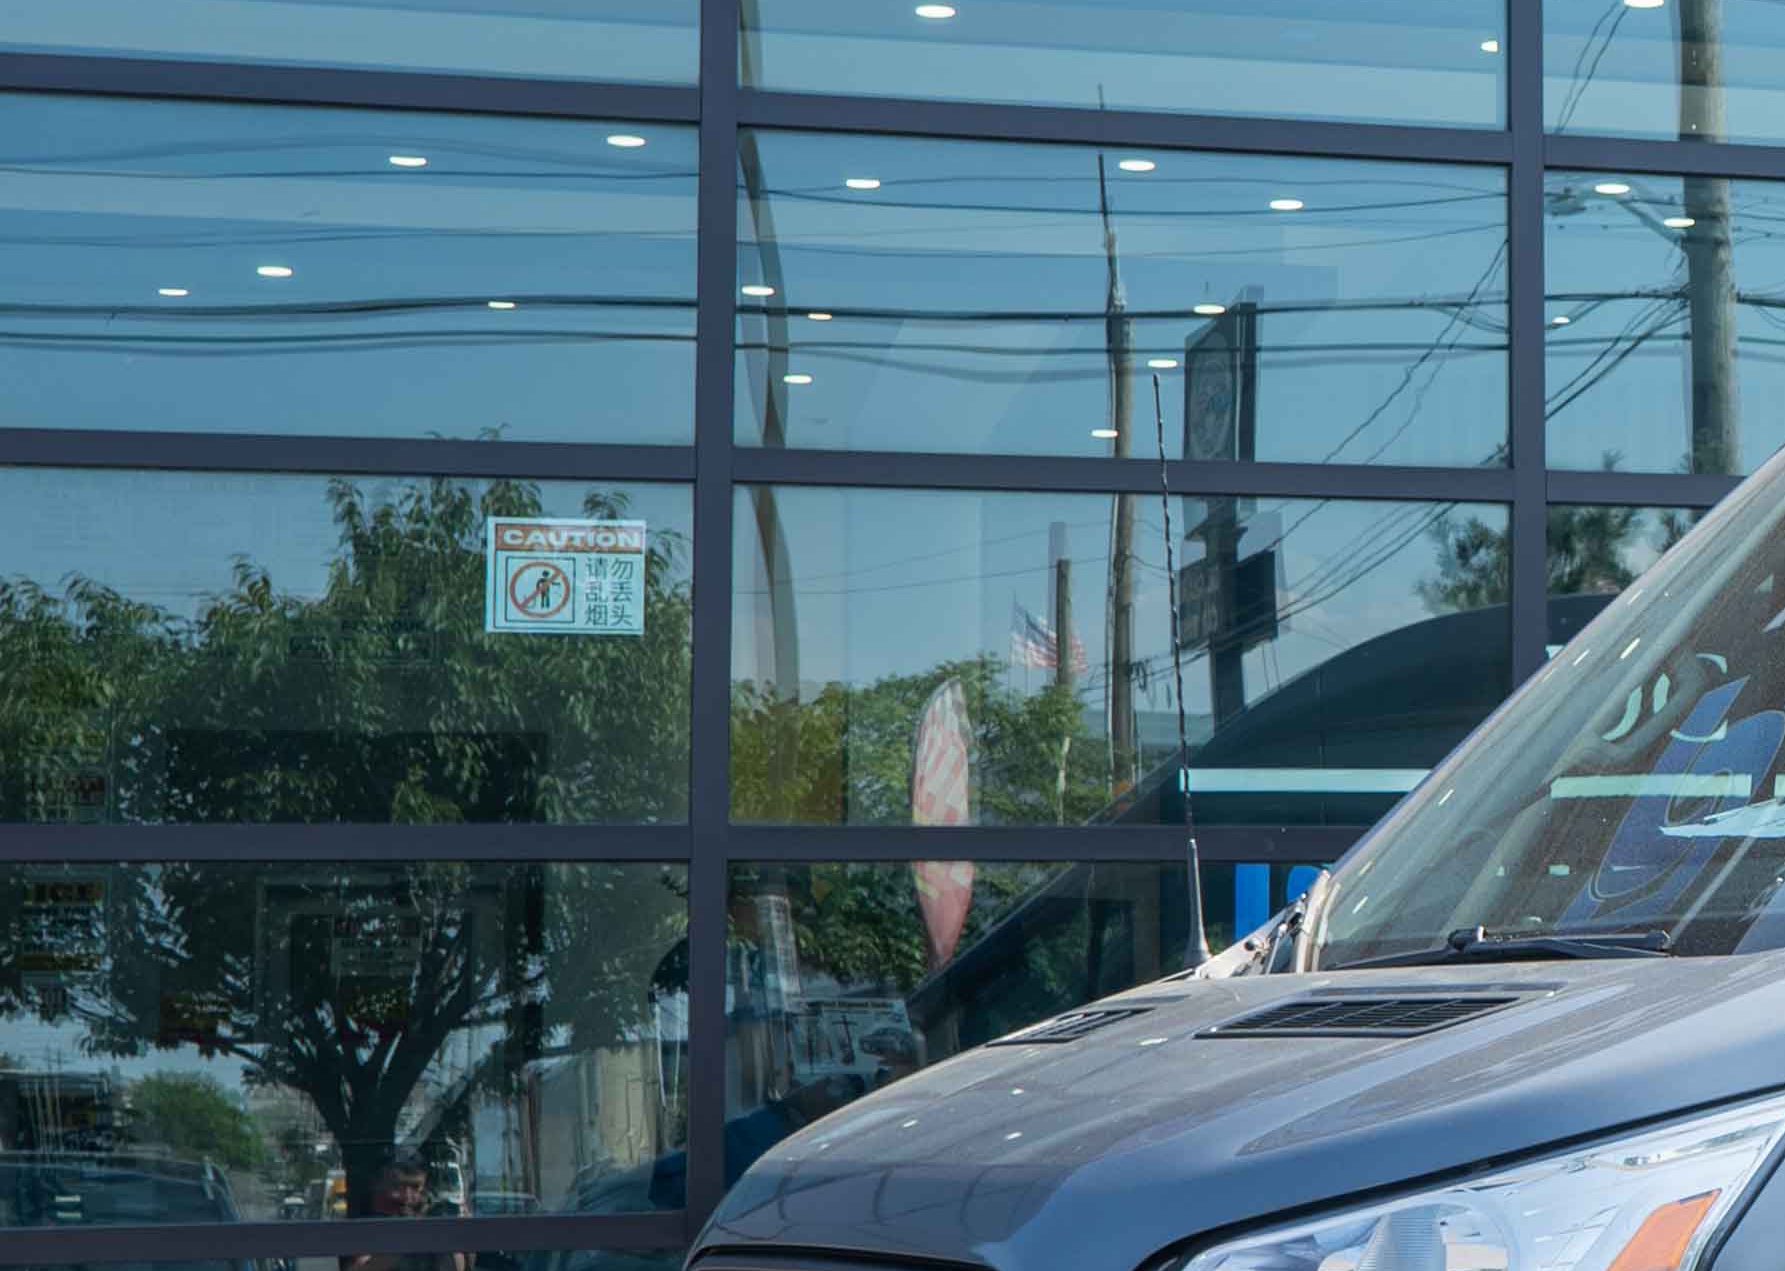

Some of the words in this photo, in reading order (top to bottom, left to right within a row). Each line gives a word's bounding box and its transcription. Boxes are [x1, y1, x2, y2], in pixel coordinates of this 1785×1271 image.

[503, 528, 641, 549] CAUTION
[585, 557, 634, 580] 请勿
[584, 604, 633, 627] 烟头
